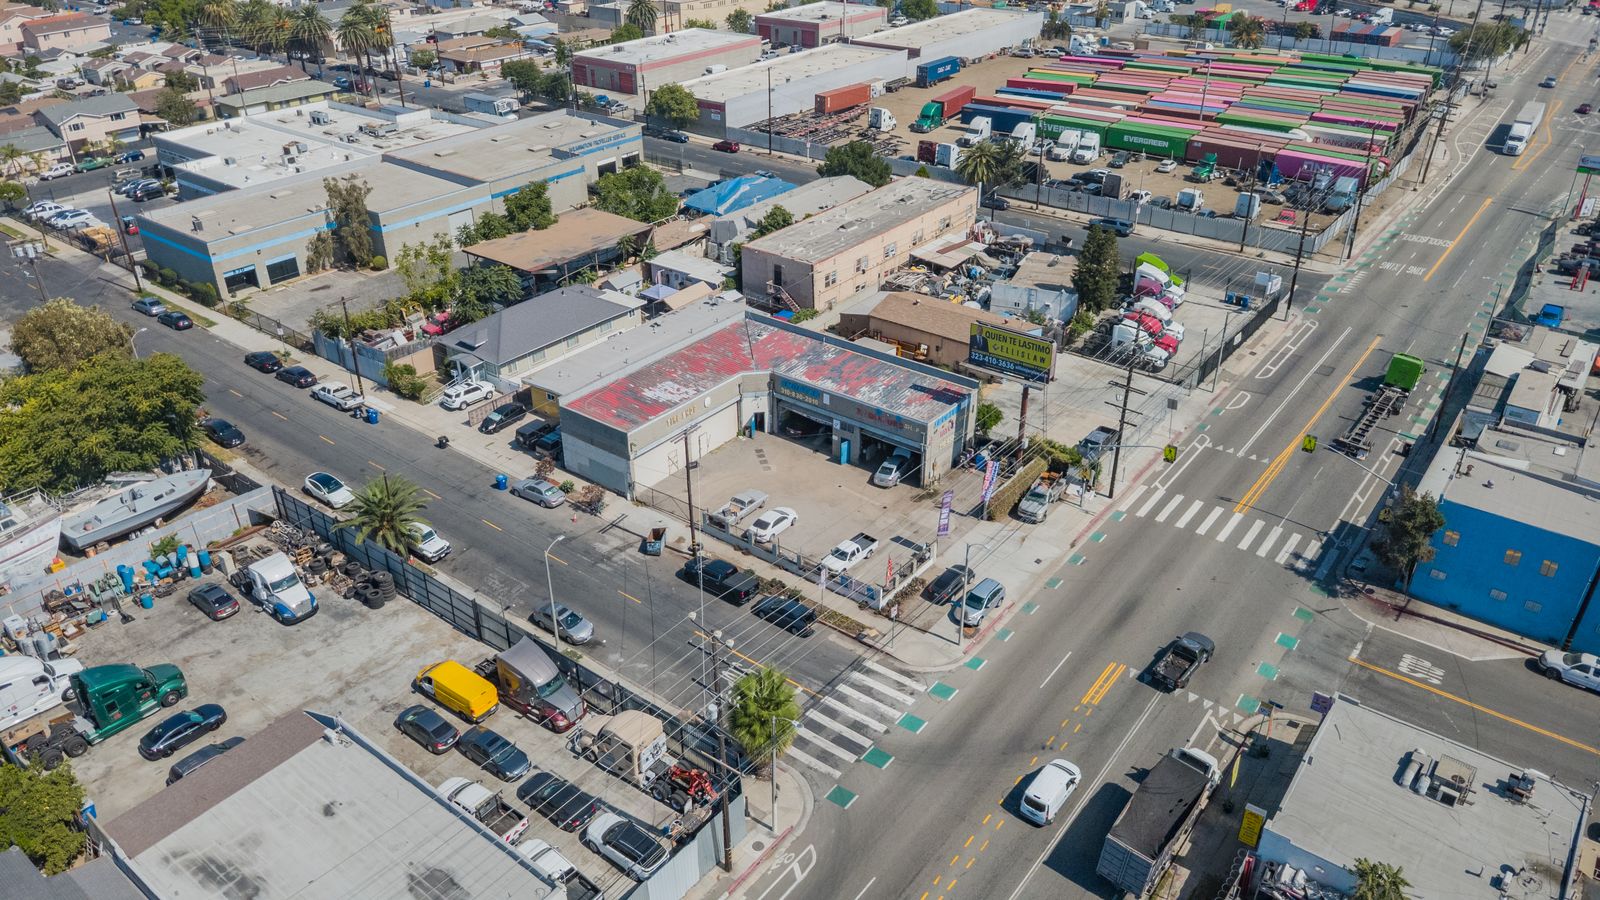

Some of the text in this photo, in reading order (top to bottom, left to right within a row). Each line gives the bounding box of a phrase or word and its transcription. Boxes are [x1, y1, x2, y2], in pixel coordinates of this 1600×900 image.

[1124, 135, 1168, 148] EVERGREEN
[1406, 265, 1426, 276] XING
[985, 330, 1007, 344] QUIEN
[1009, 336, 1017, 346] TE
